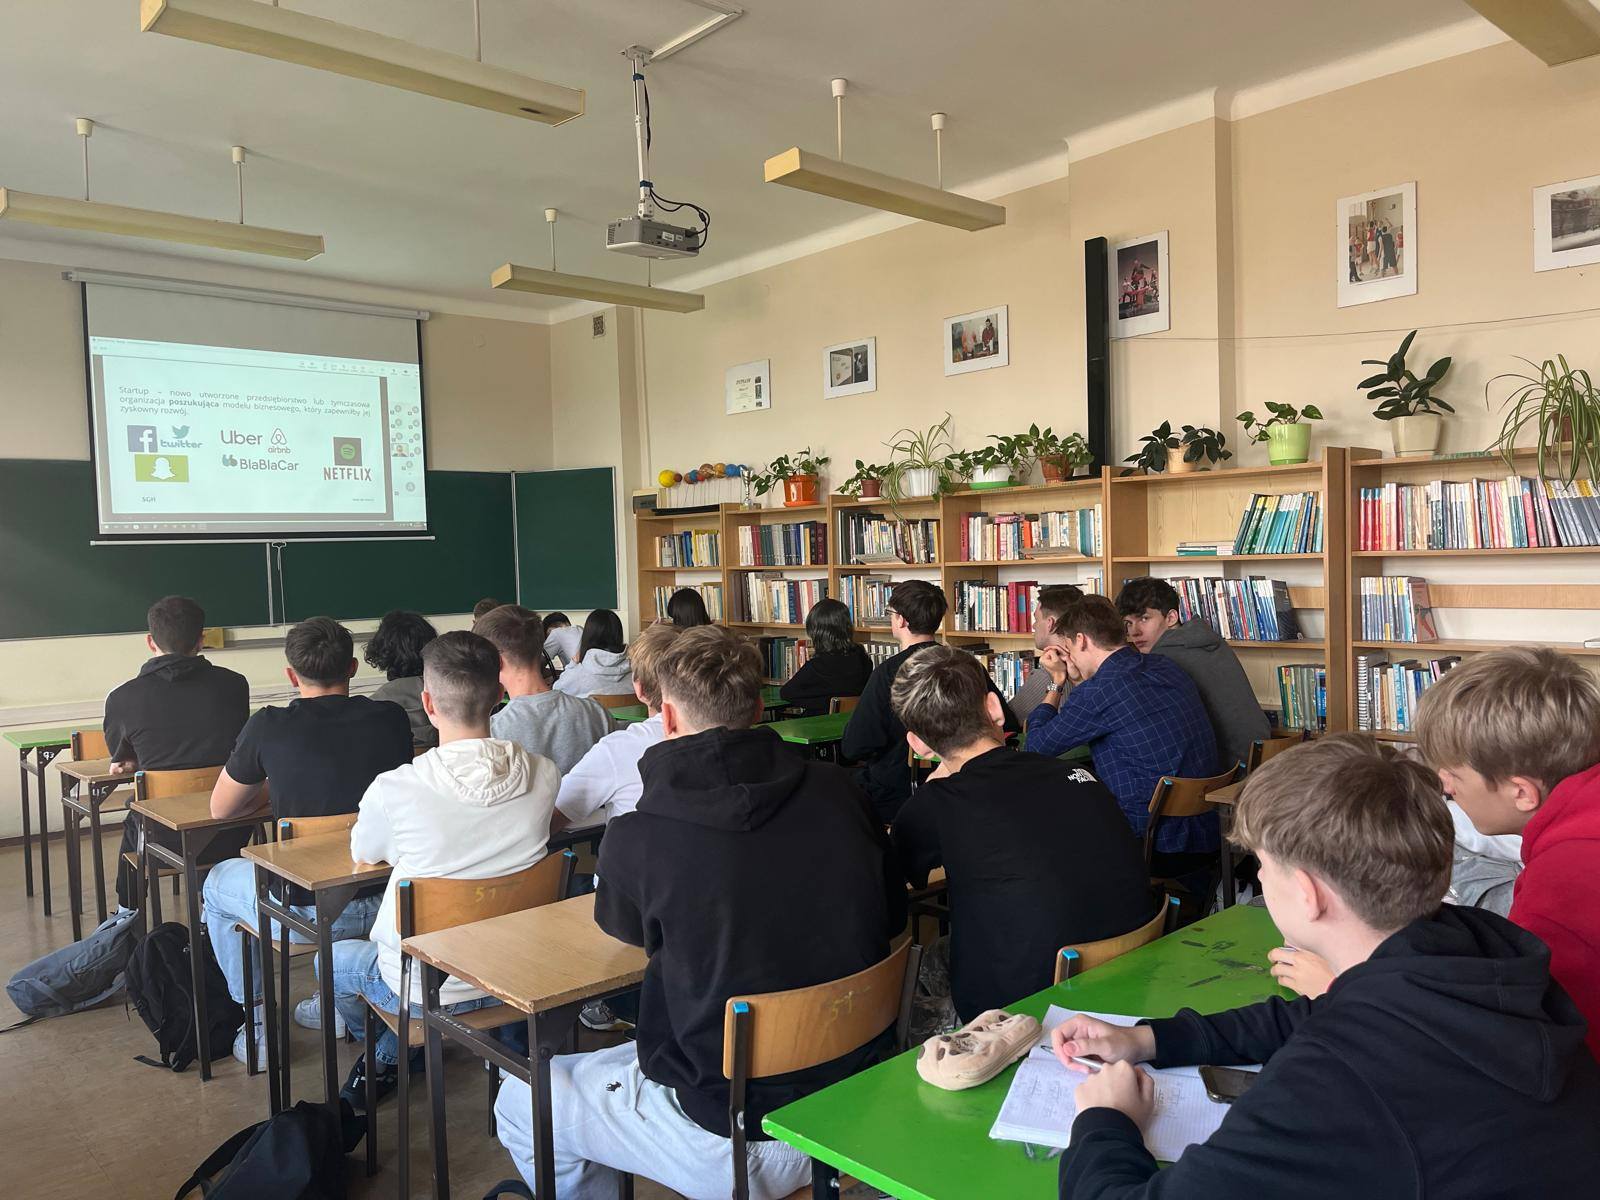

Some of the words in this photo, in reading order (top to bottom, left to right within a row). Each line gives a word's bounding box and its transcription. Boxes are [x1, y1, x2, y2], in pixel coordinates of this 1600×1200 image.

[119, 386, 149, 395] Startup
[199, 391, 239, 400] utworzone
[247, 394, 307, 404] przedsiębiorstwo
[331, 400, 370, 408] tymczasowa
[120, 396, 165, 405] organizacja
[169, 398, 219, 408] poszukująca
[223, 401, 251, 409] modelu
[304, 406, 321, 414] który
[120, 405, 158, 414] zyskowny
[220, 430, 263, 445] Uber
[160, 440, 202, 449] twitter
[267, 446, 291, 454] airbnb
[239, 458, 299, 471] BlaBlaCar
[323, 467, 372, 481] NETFLIX
